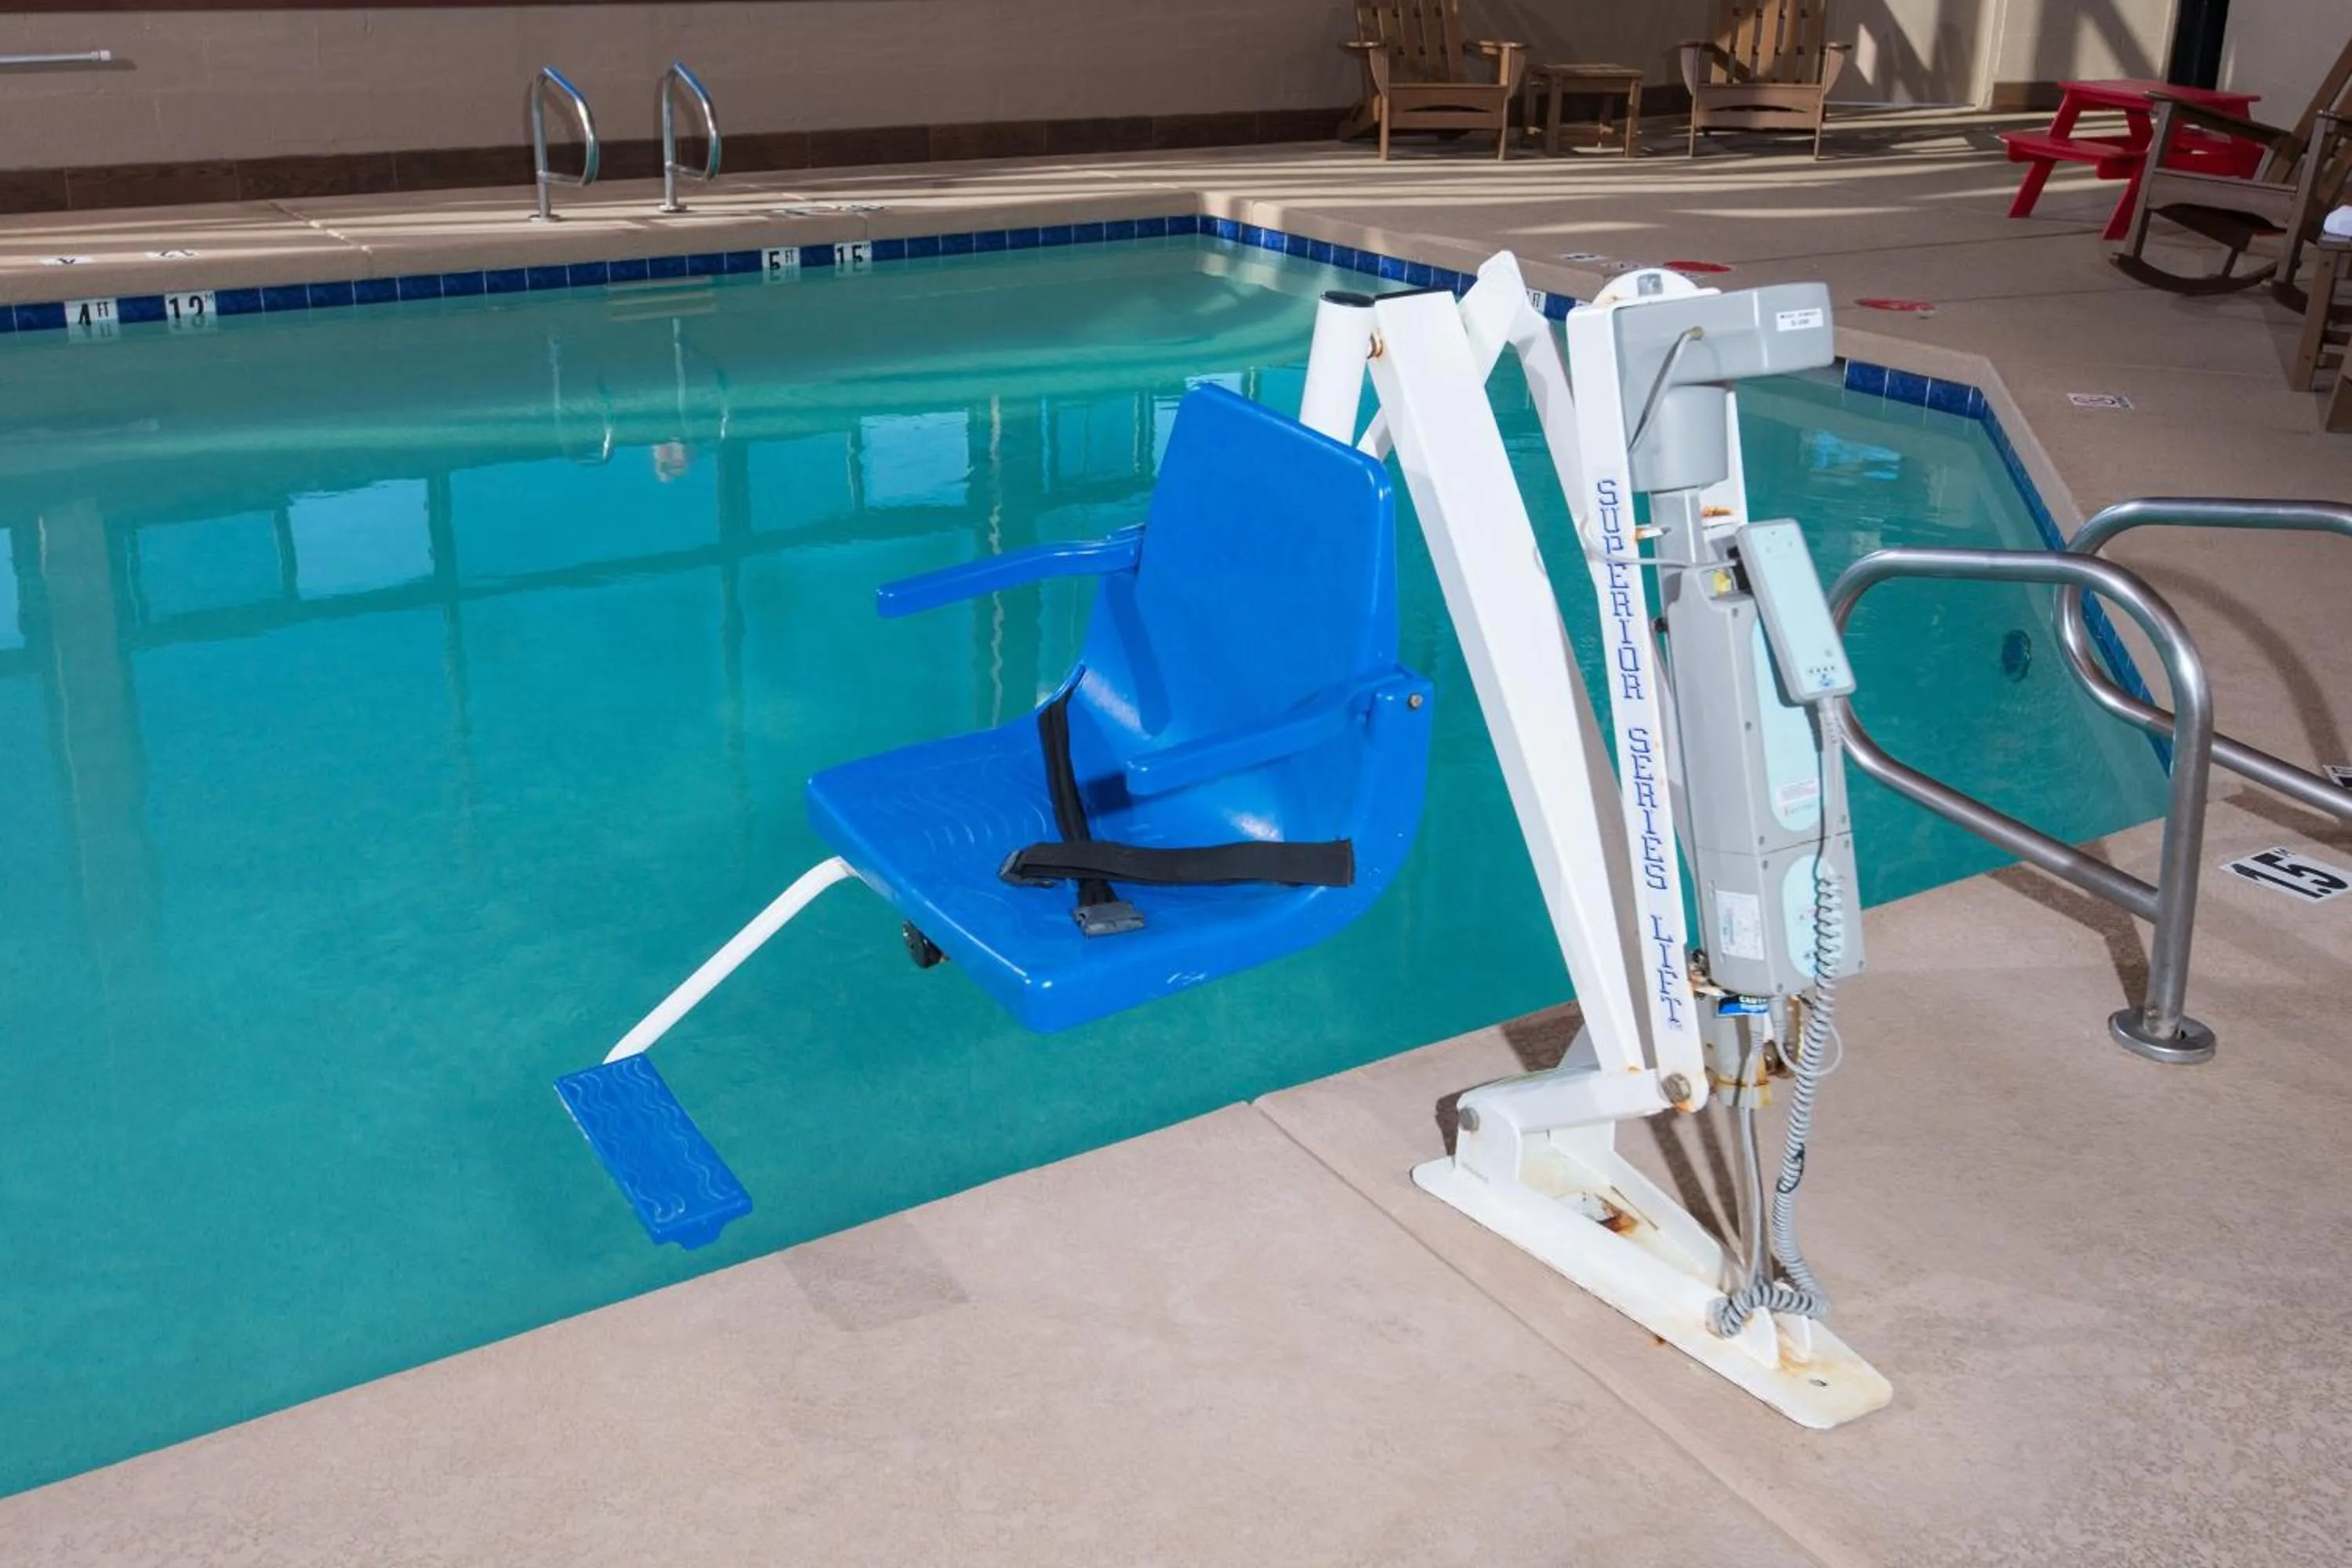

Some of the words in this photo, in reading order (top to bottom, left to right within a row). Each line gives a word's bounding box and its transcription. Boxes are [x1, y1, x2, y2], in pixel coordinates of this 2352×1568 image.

[768, 250, 781, 270] 5
[96, 301, 109, 318] FT
[1596, 480, 1644, 700] SUPERIOR
[1628, 728, 1668, 891] SERIES
[1650, 914, 1682, 1023] LIFT
